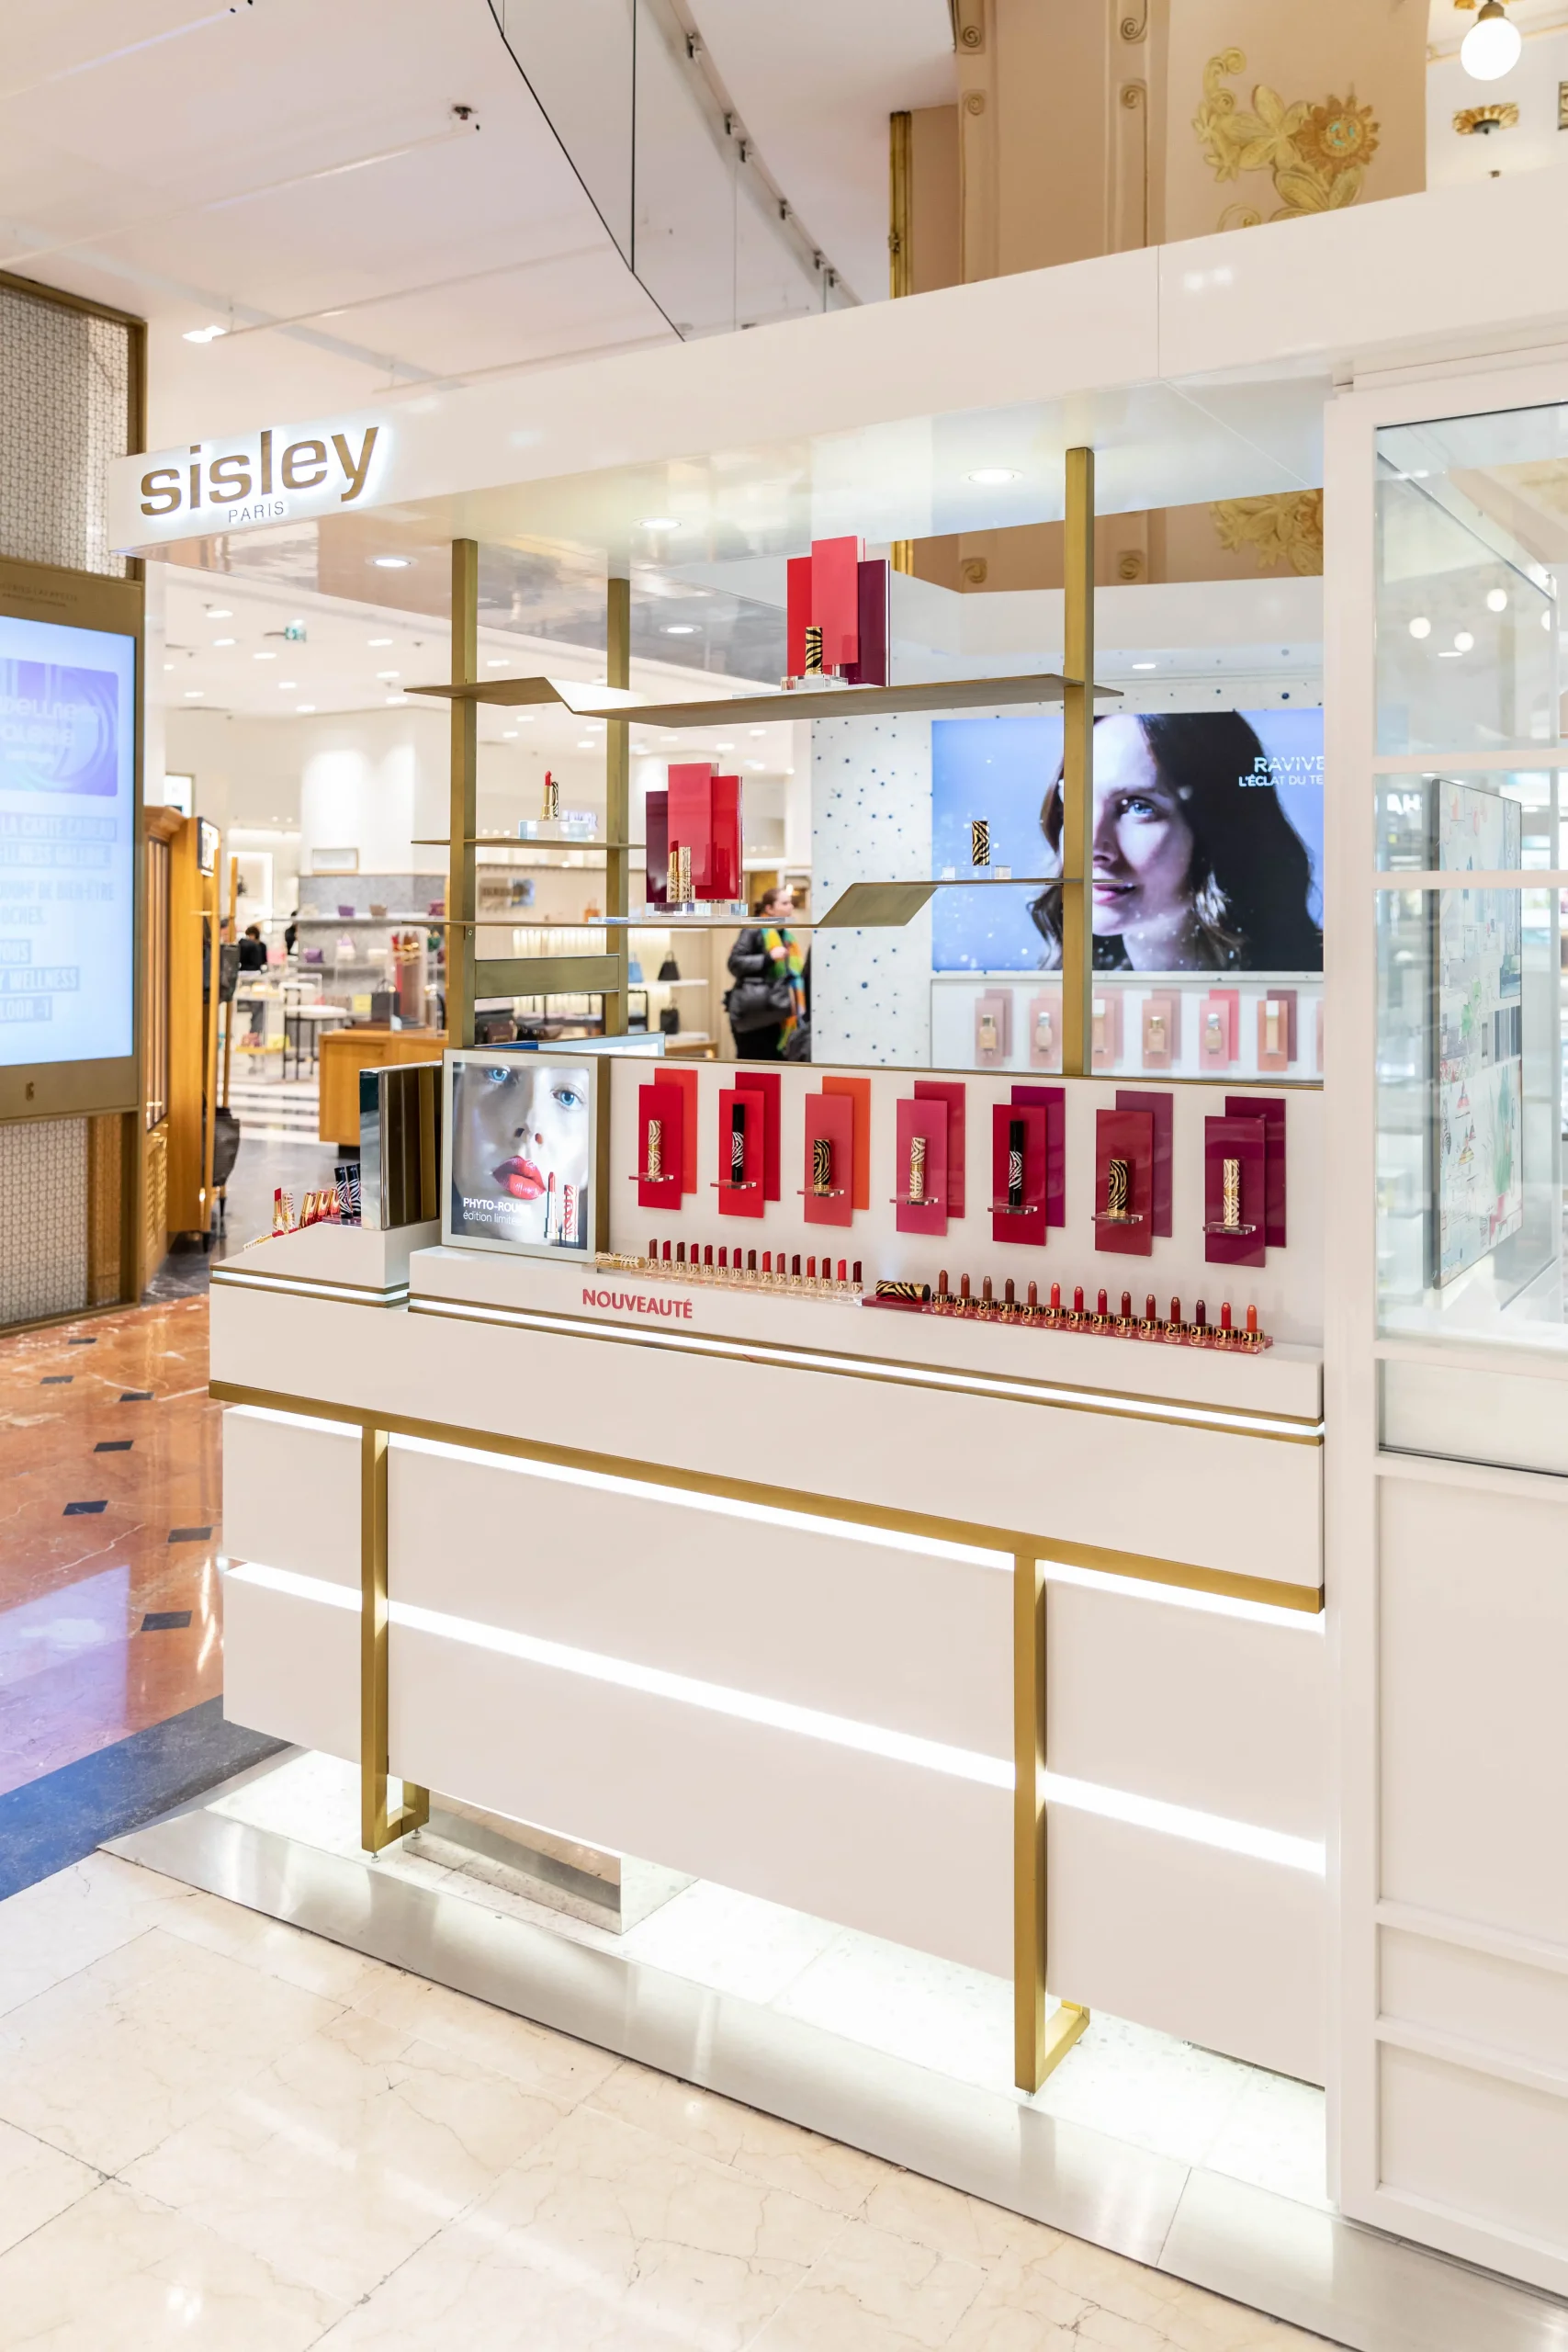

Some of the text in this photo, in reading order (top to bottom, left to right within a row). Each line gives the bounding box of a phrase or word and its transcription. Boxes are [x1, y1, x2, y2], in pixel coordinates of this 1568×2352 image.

[141, 425, 379, 516] sisley
[229, 501, 285, 523] PARIS
[1238, 774, 1324, 787] L'ÉCLAT DU TE
[462, 1209, 492, 1223] édition
[463, 1197, 532, 1216] PHYTO-ROU
[581, 1288, 694, 1319] NOUVEAUTÉ
